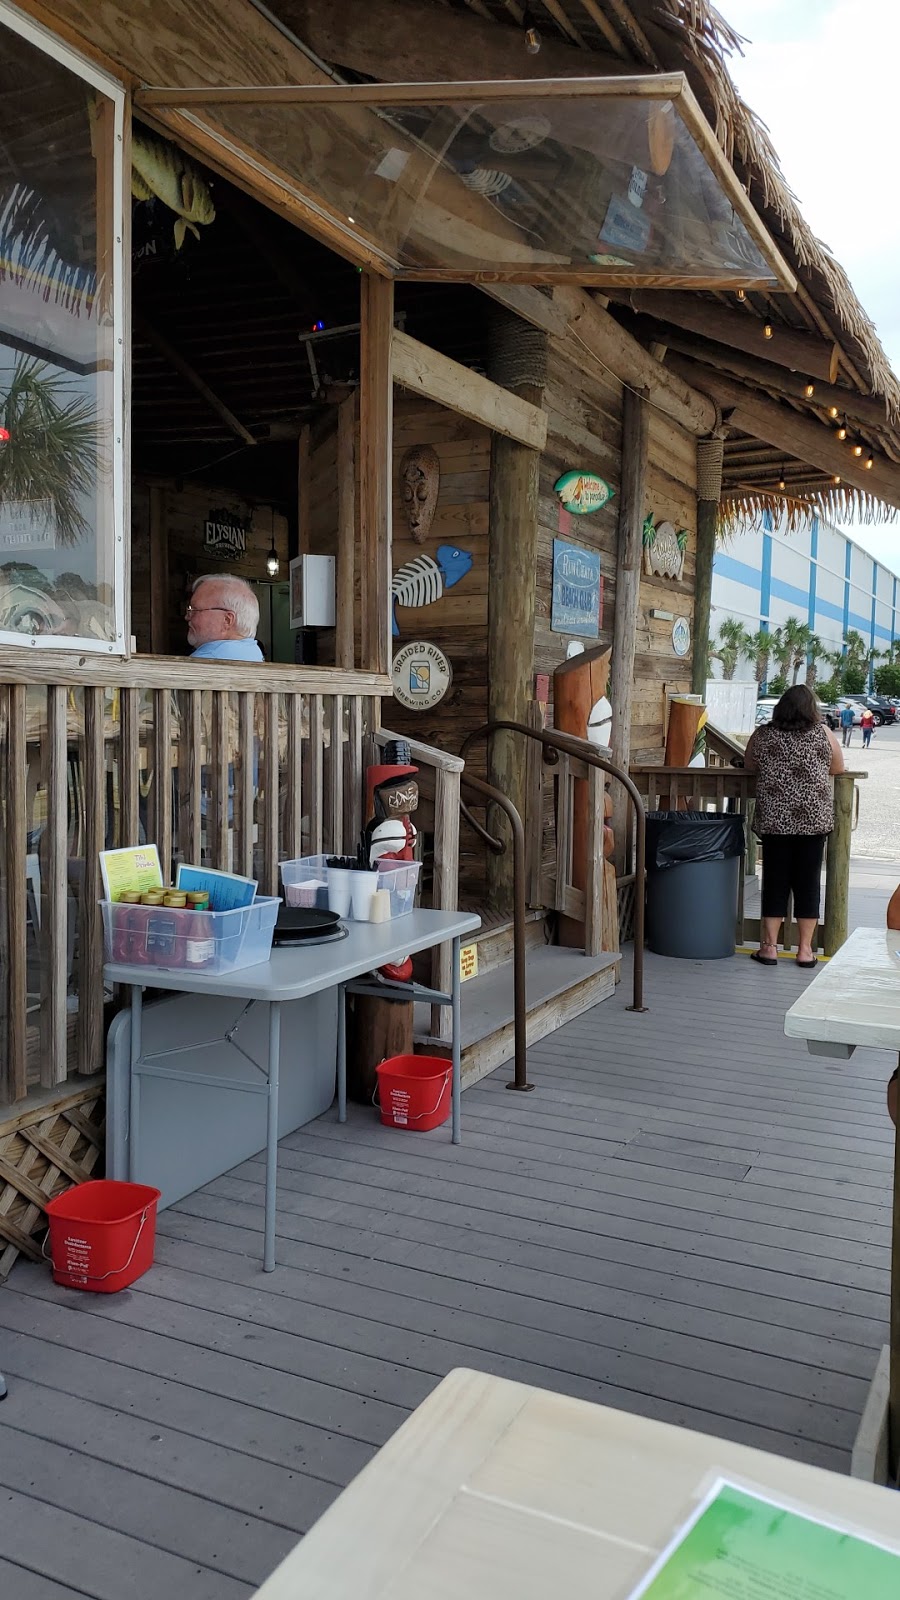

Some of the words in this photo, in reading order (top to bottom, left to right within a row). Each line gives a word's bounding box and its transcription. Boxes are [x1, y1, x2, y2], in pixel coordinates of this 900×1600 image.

[206, 521, 246, 551] ELYSIAN
[394, 645, 426, 673] BRAIDED
[427, 647, 447, 673] RIVER
[396, 686, 430, 706] BREWING
